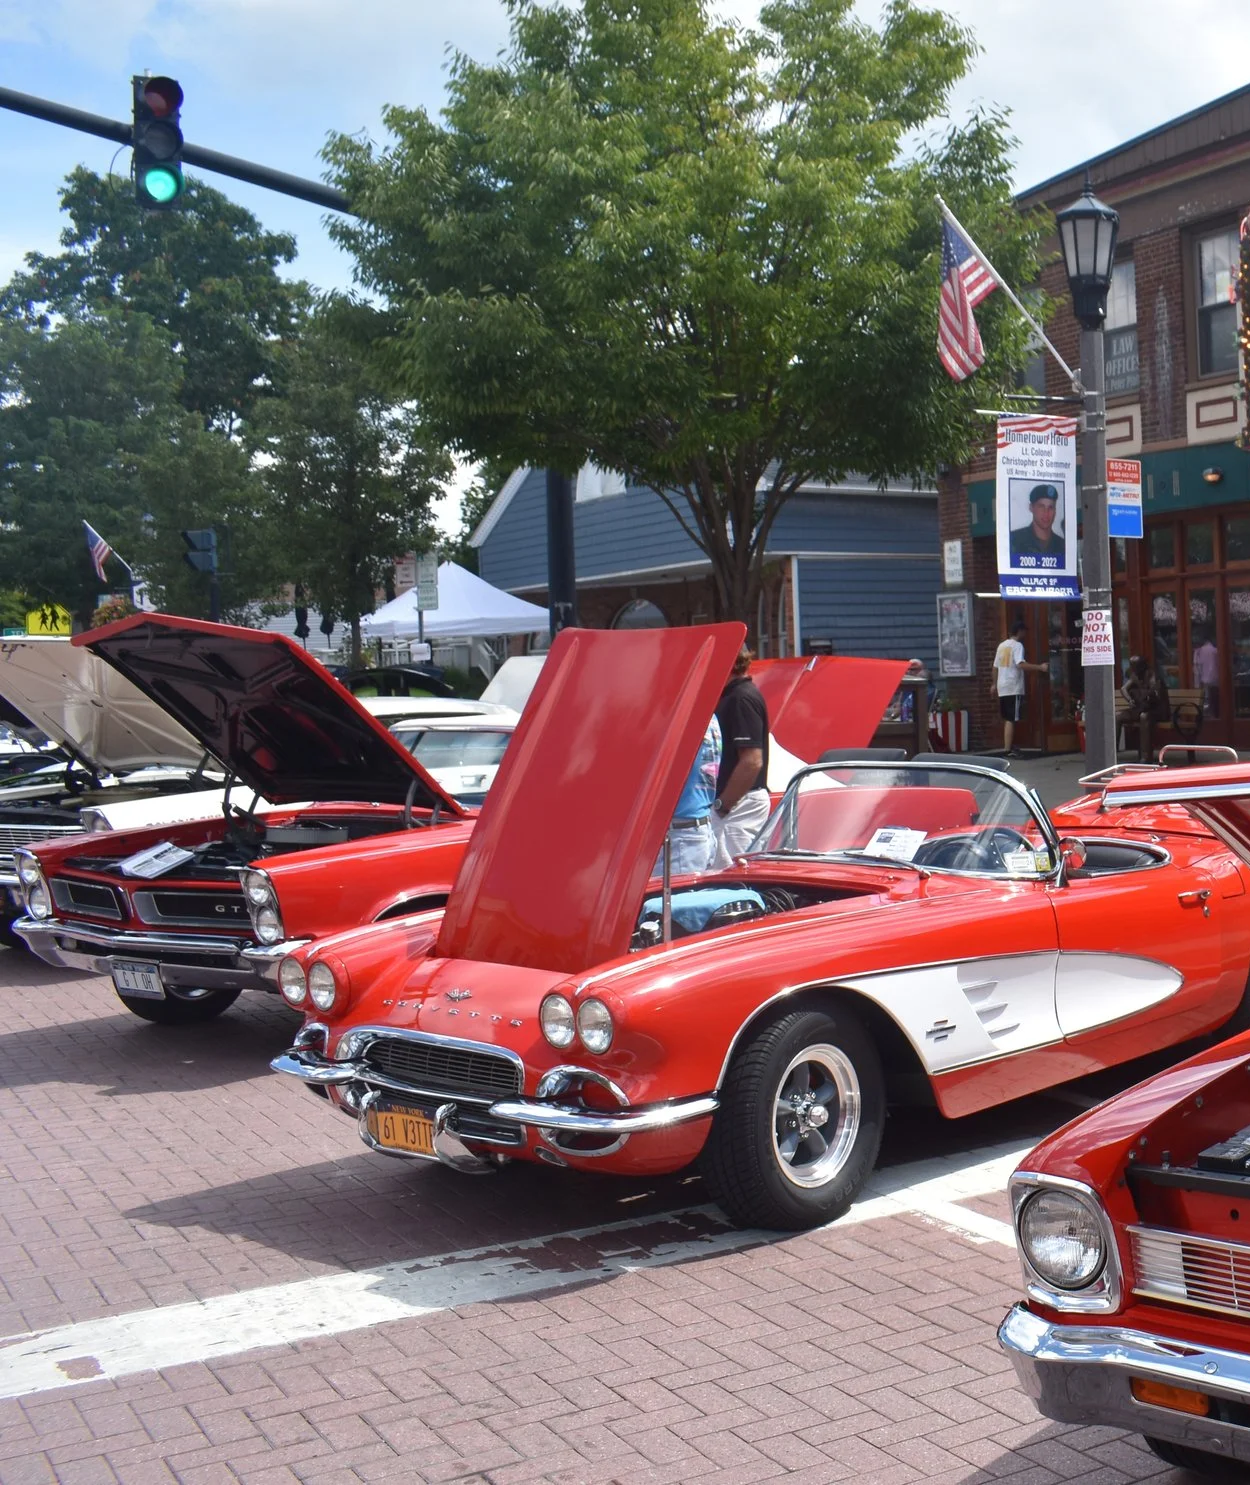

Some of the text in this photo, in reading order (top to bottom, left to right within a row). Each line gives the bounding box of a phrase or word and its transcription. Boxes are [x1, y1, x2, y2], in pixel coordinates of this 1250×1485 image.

[1112, 335, 1135, 356] LAW
[1005, 427, 1069, 447] Hometown Hero
[1031, 447, 1053, 458] Colonel
[1001, 455, 1038, 469] Christopher
[1040, 458, 1044, 467] S
[1006, 468, 1014, 476] US
[1014, 469, 1028, 477] Army
[1019, 556, 1037, 567] 2000
[1041, 557, 1058, 568] 2022
[1005, 586, 1075, 597] EAST AURORA
[1087, 612, 1103, 621] DO
[1085, 623, 1107, 632] NOT
[1084, 634, 1111, 644] PARK
[382, 998, 523, 1028] CORVETTE
[391, 1104, 425, 1118] NEW YORK
[384, 1116, 396, 1141] 61
